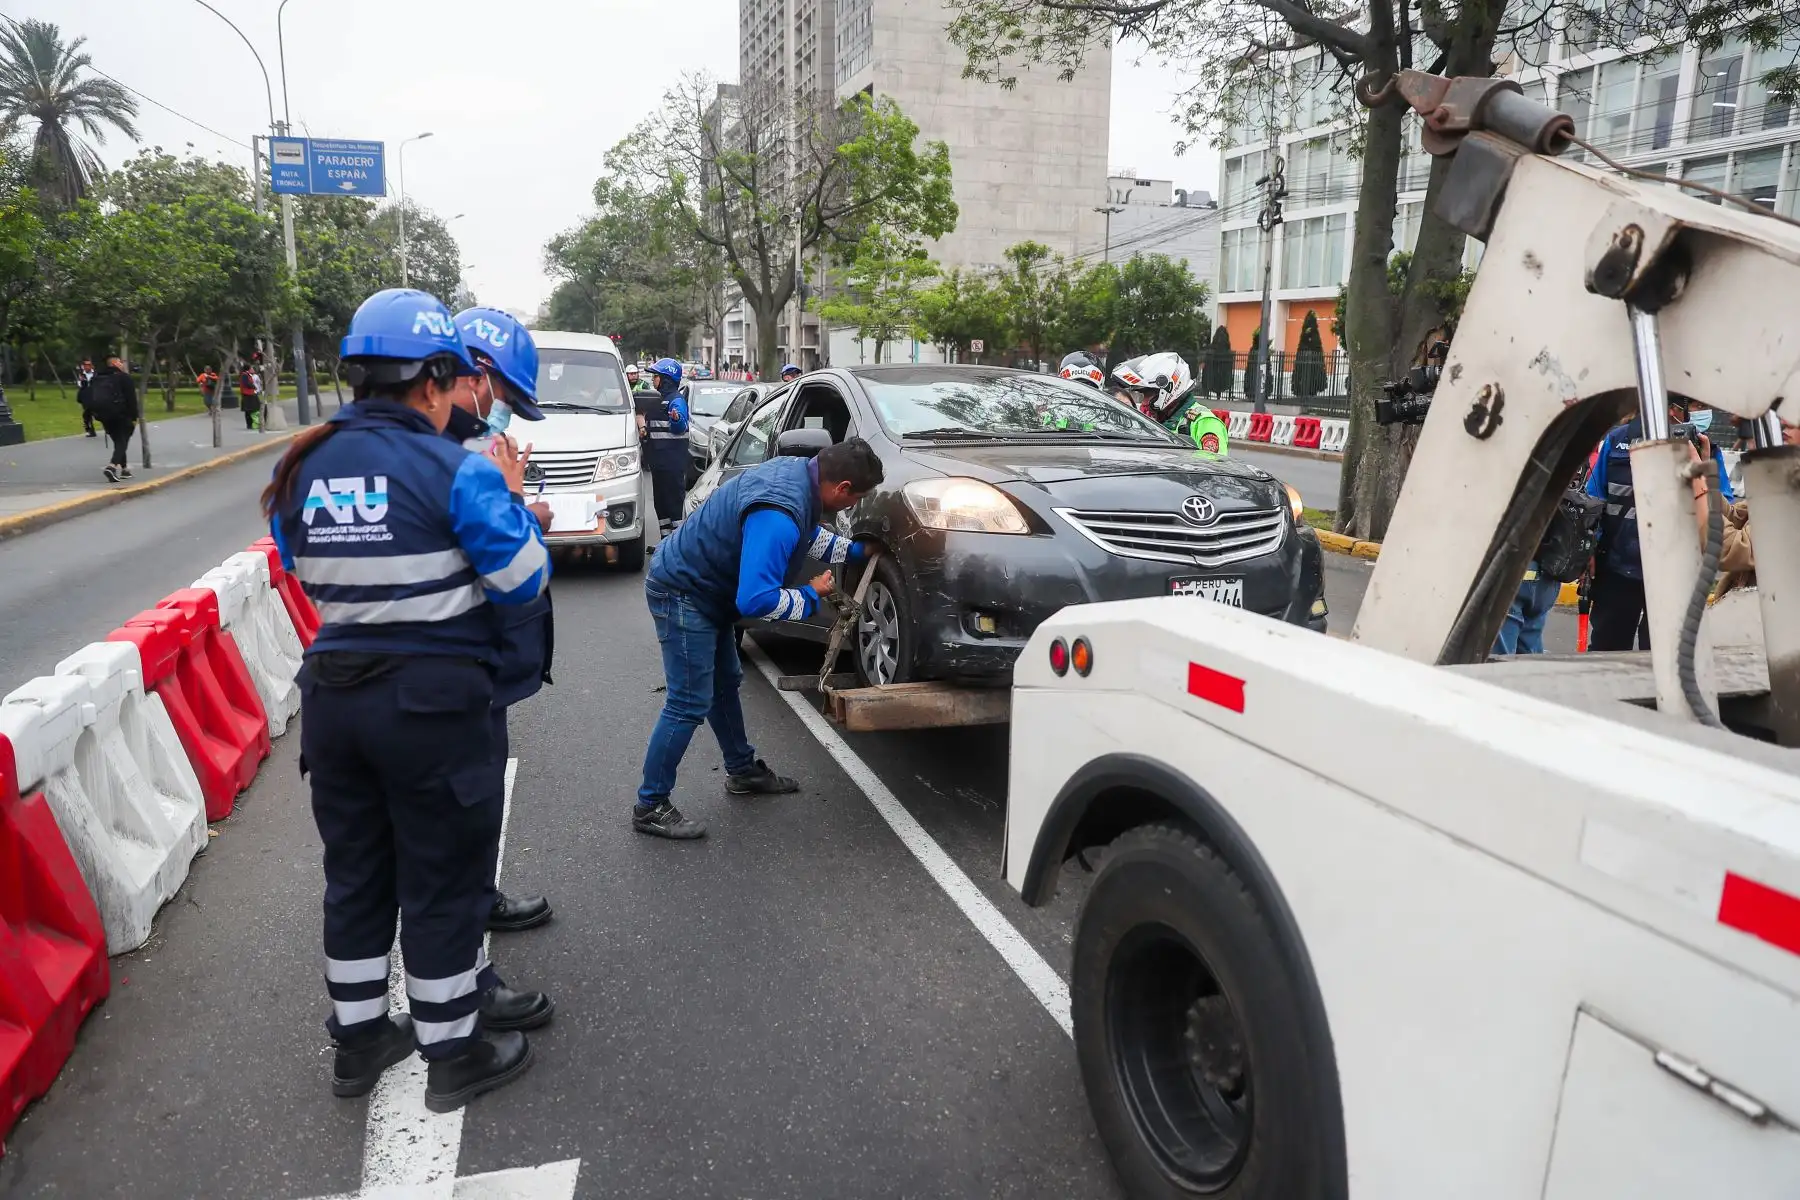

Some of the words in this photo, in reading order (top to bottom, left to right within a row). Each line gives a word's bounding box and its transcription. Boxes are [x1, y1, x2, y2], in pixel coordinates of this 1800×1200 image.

[318, 155, 374, 167] PARADERO
[281, 170, 299, 178] RUTA
[327, 169, 367, 179] ESPAÑA
[276, 179, 305, 187] TRONCAL
[412, 311, 456, 337] ATU
[463, 318, 511, 347] ATU
[301, 475, 389, 526] ATU
[1195, 579, 1222, 589] PERU
